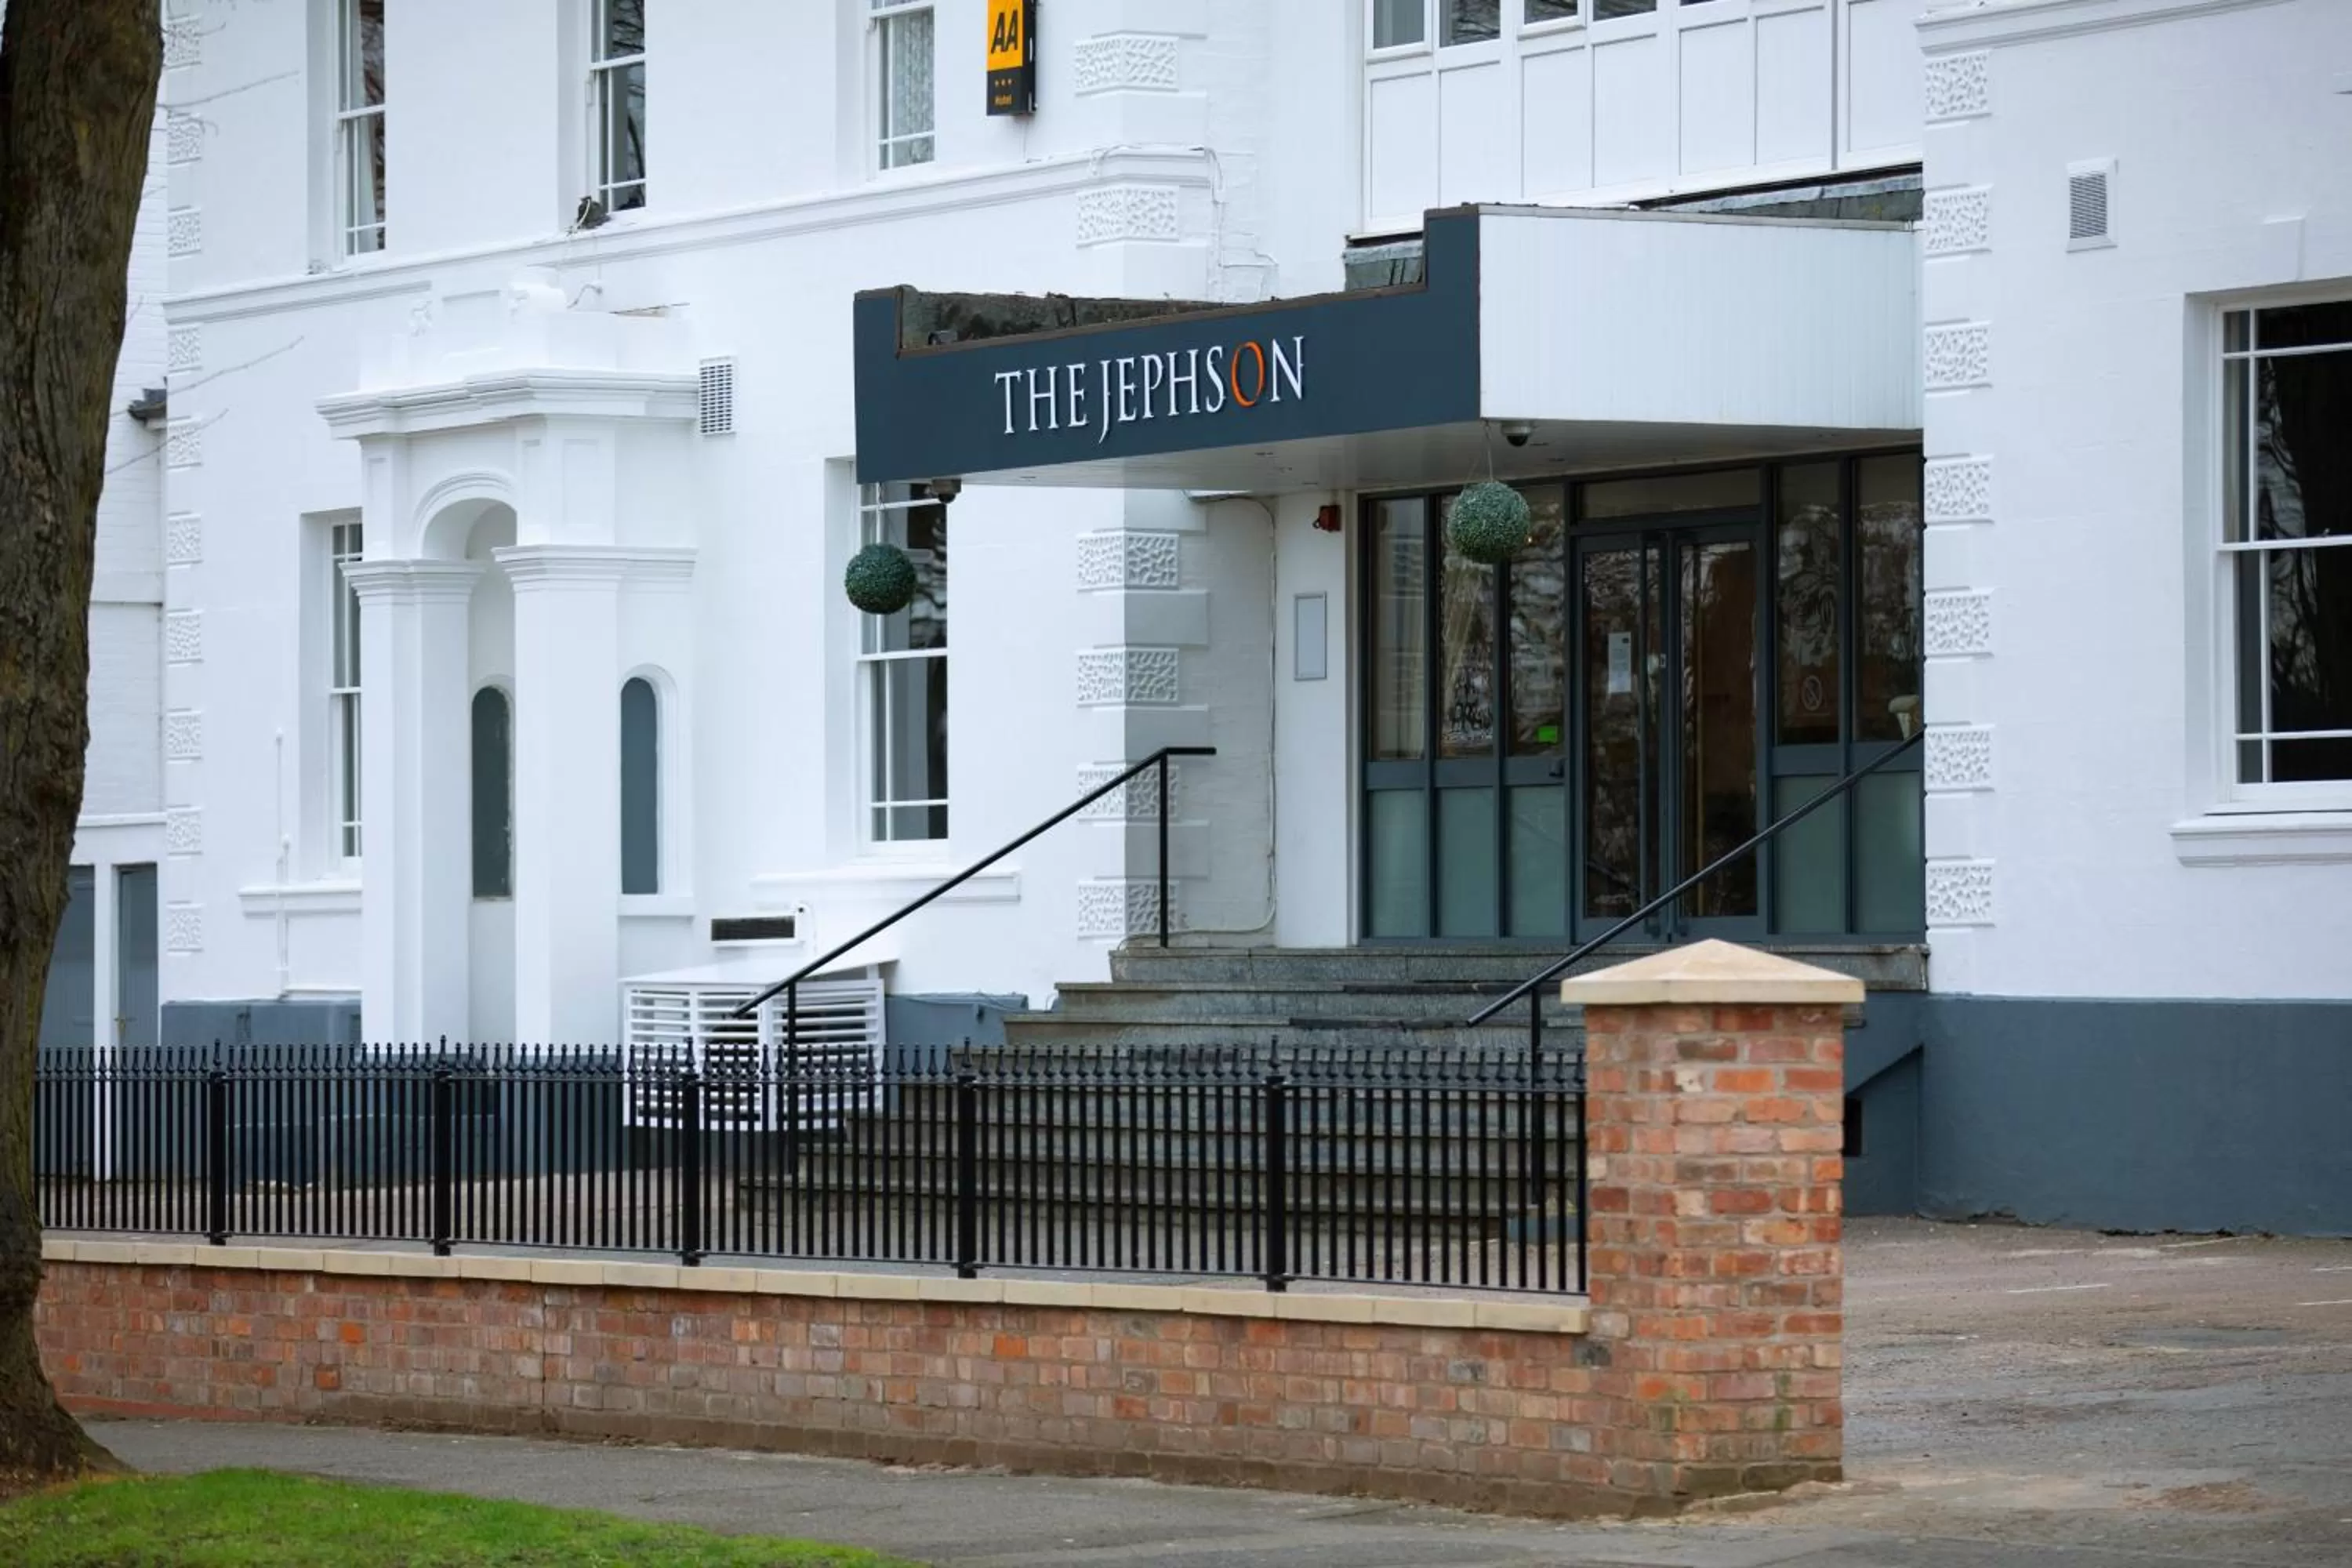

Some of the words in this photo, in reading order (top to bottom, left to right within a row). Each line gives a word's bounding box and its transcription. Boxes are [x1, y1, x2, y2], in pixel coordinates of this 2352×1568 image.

[991, 9, 1018, 53] AA
[994, 363, 1090, 434] THE
[1098, 336, 1305, 444] JEPHSON
